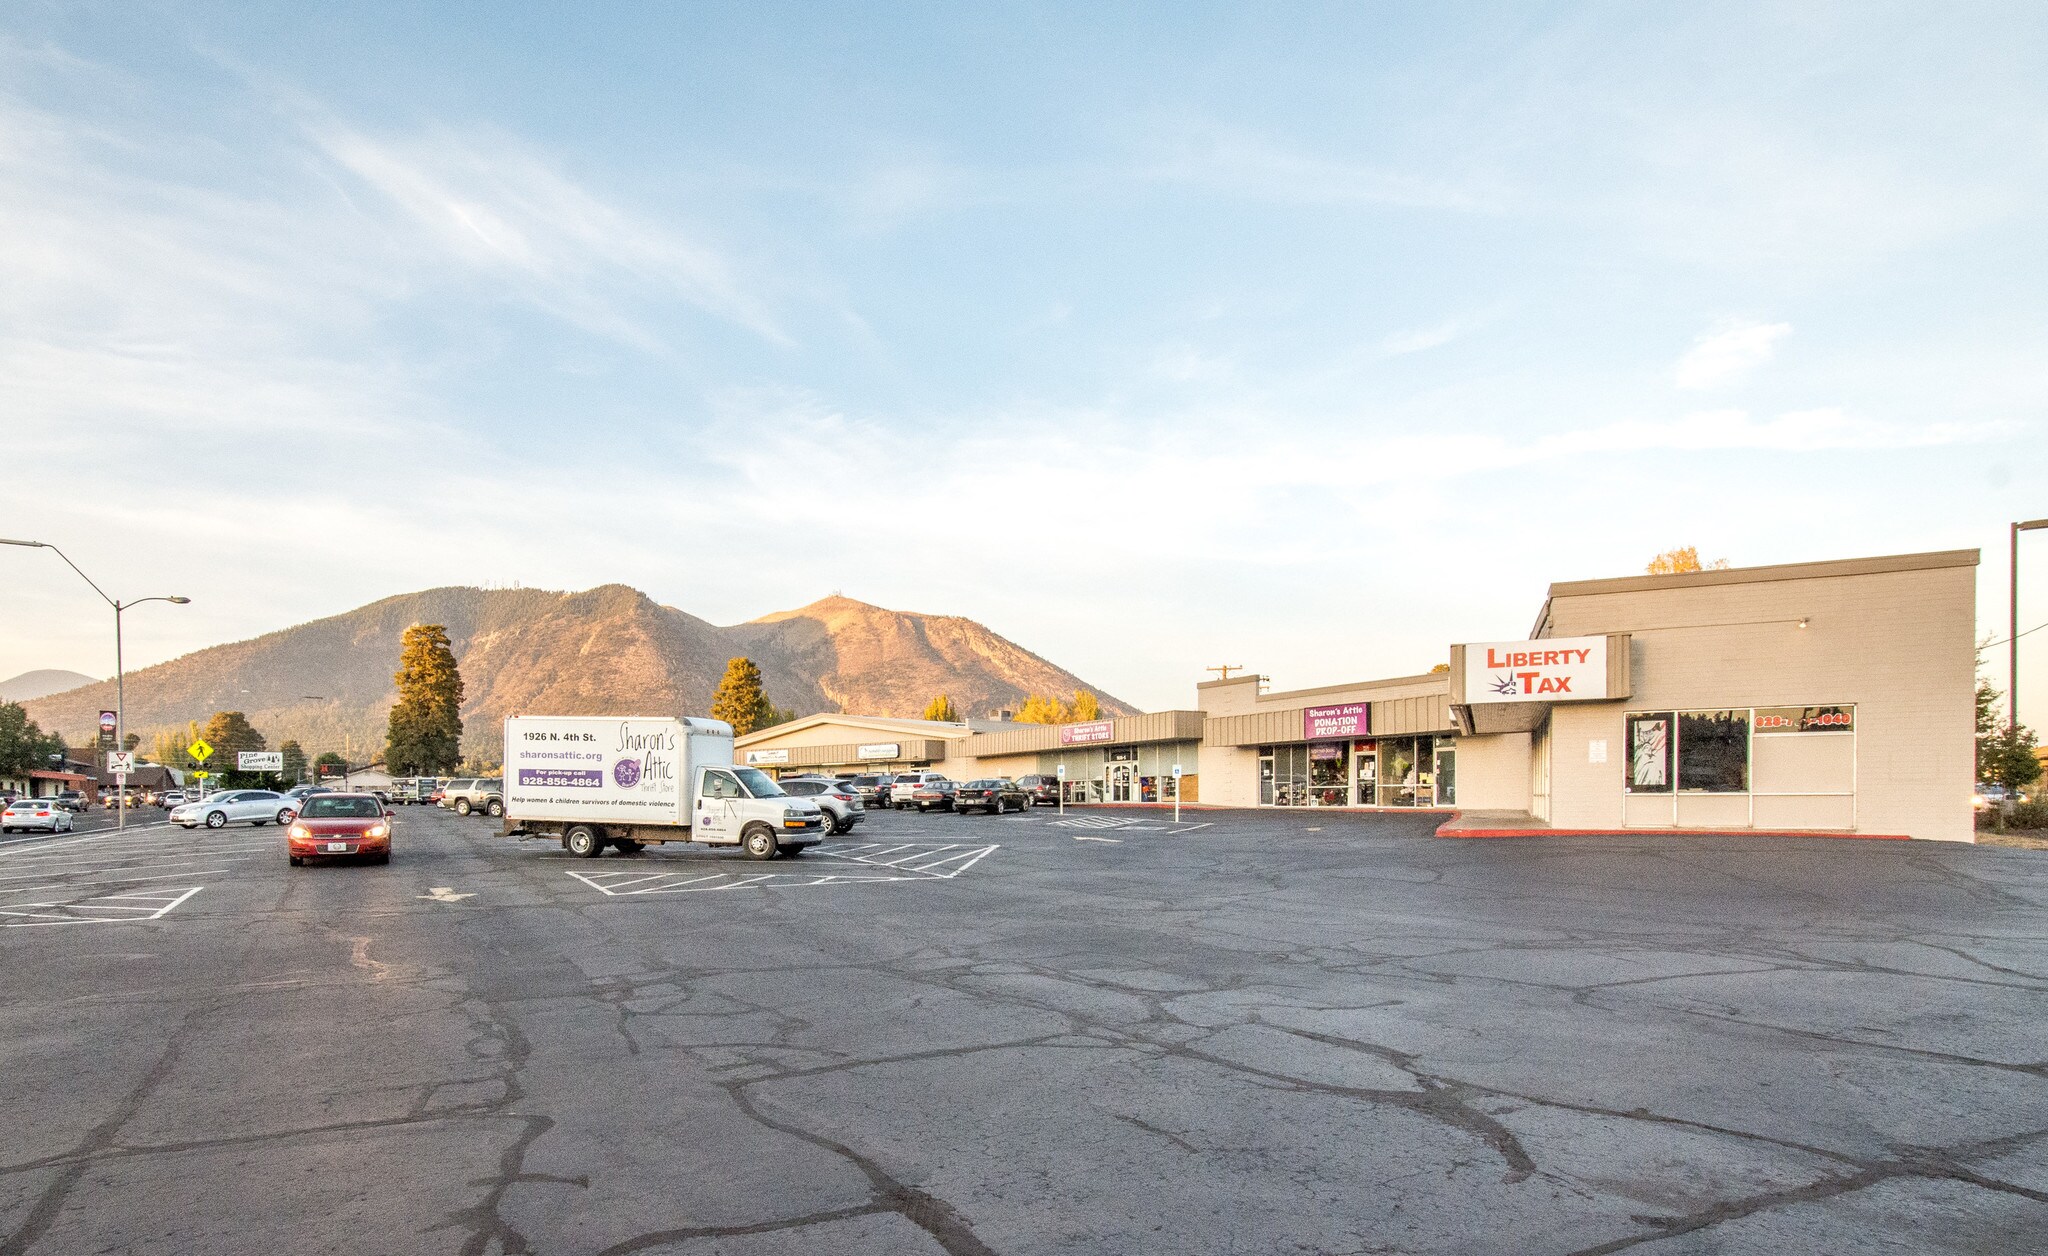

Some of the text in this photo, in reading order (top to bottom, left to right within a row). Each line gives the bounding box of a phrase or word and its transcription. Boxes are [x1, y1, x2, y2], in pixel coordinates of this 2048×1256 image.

[1487, 648, 1591, 669] LIBERTY
[1516, 671, 1572, 694] TAX
[1309, 706, 1363, 717] Sharon's Attic
[1314, 716, 1358, 727] DONATION
[1755, 713, 1851, 728] 928-7-1040
[1071, 731, 1110, 741] THRIFT STORE
[1315, 725, 1356, 736] DROP-OFF
[523, 732, 597, 742] 1926 N. 4th St.
[616, 721, 675, 752] Sharon's
[520, 750, 603, 762] sharonsattic.org
[643, 750, 673, 780] Attic
[522, 776, 600, 787] 928-856-4864
[511, 796, 526, 804] Help
